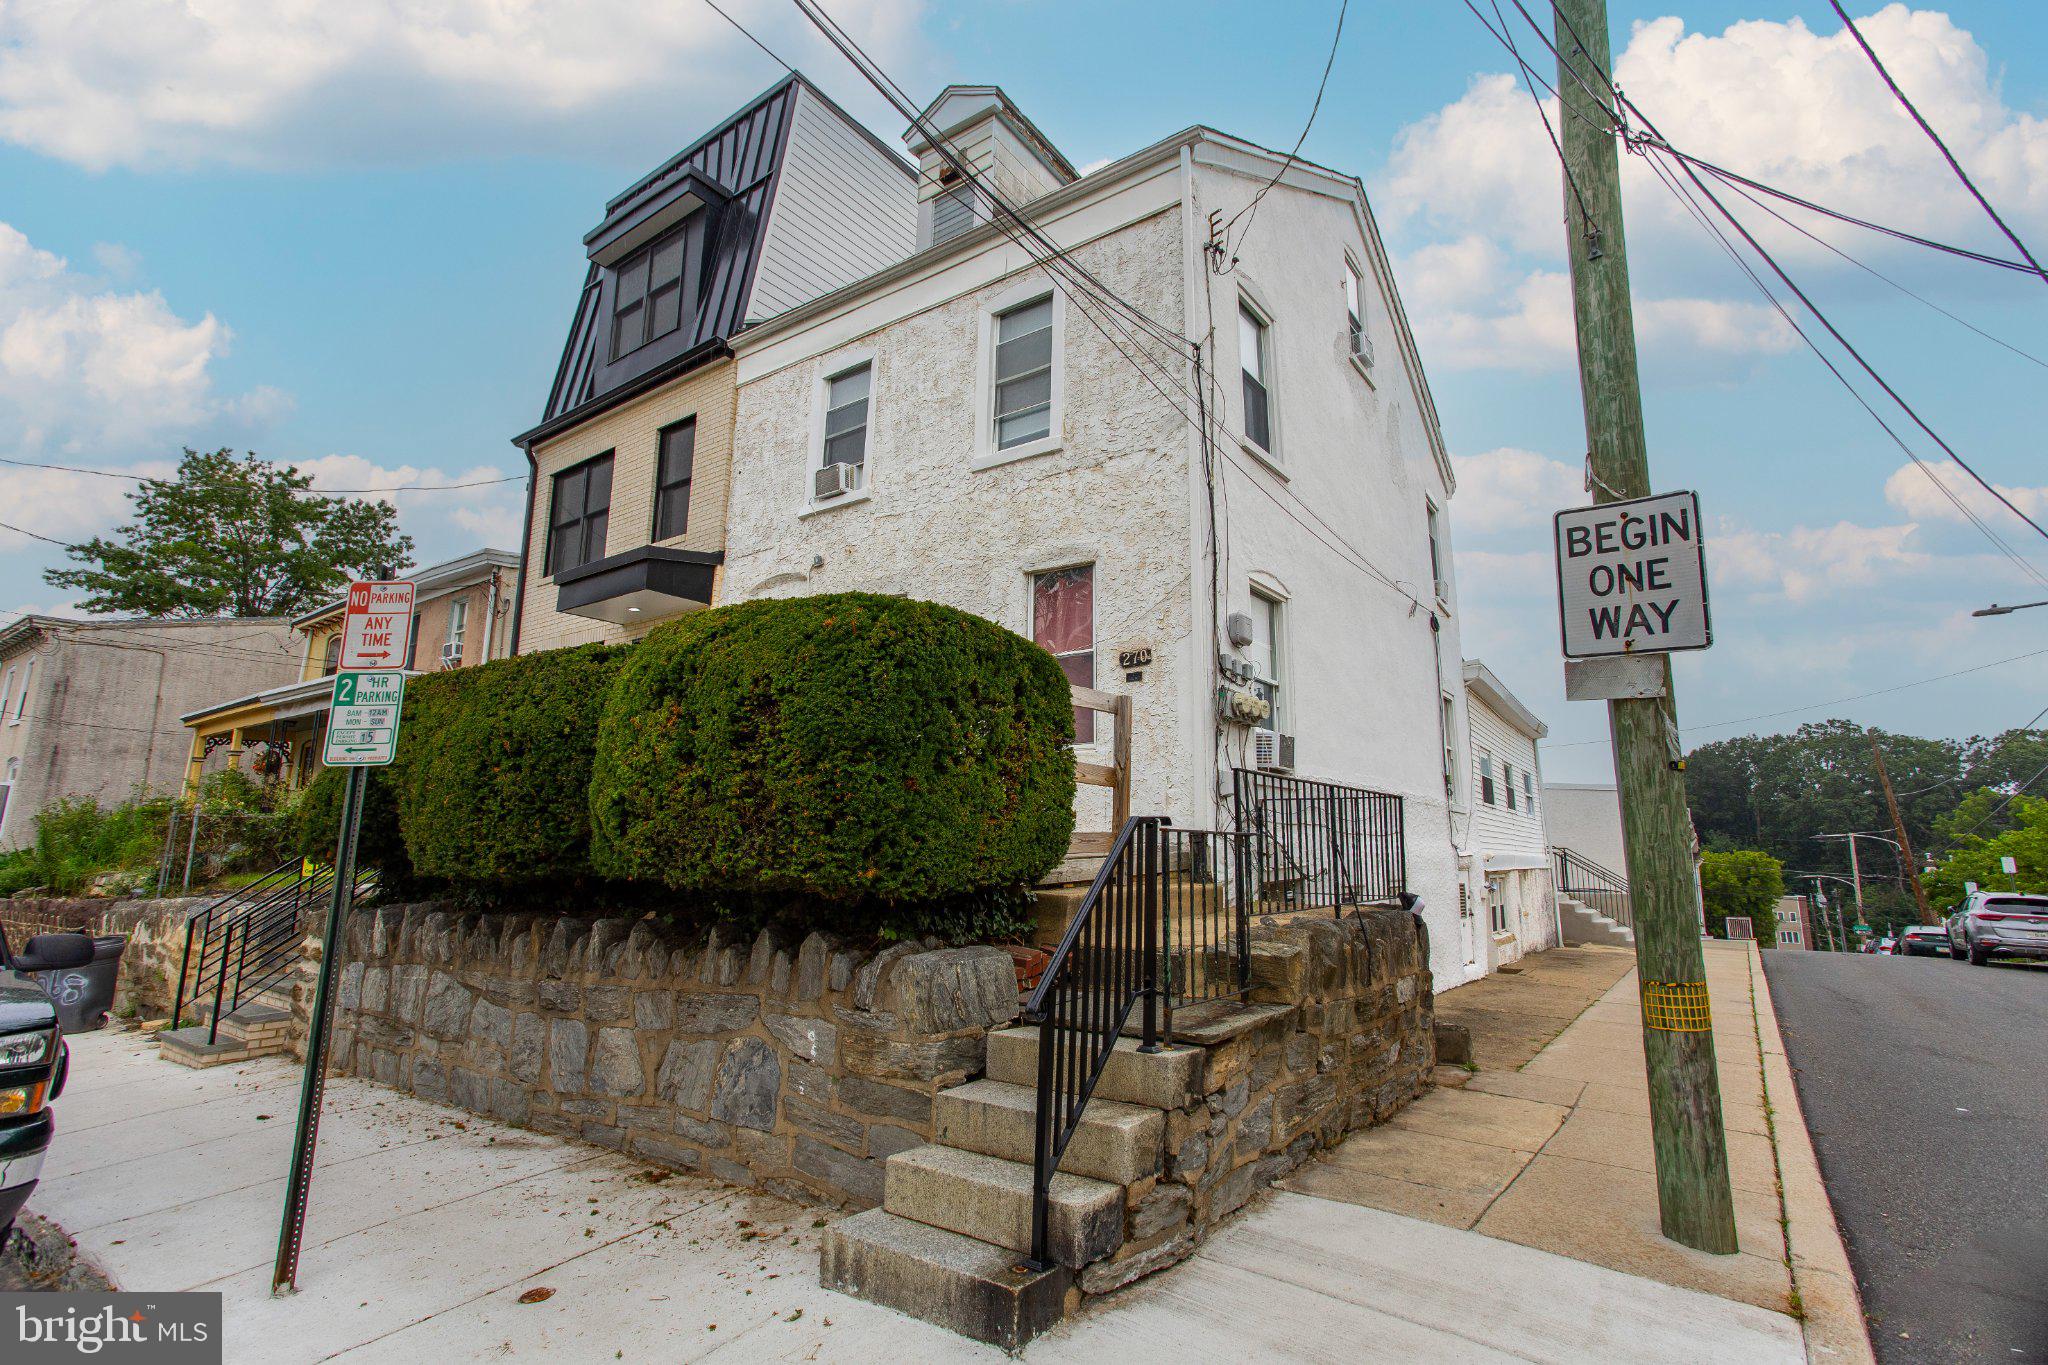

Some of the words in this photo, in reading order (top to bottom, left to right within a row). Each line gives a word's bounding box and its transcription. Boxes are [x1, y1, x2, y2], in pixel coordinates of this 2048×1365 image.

[1566, 508, 1690, 558] BEGIN
[1589, 557, 1672, 597] ONE
[350, 591, 368, 607] NO
[371, 592, 410, 604] PARKING
[364, 616, 393, 630] ANY
[1588, 599, 1680, 640] WAY
[362, 633, 392, 646] TIME
[338, 678, 353, 701] 2
[371, 676, 389, 688] HR
[355, 691, 398, 703] PARKING
[345, 718, 362, 726] MON
[369, 718, 385, 726] SUN
[360, 731, 374, 744] 15
